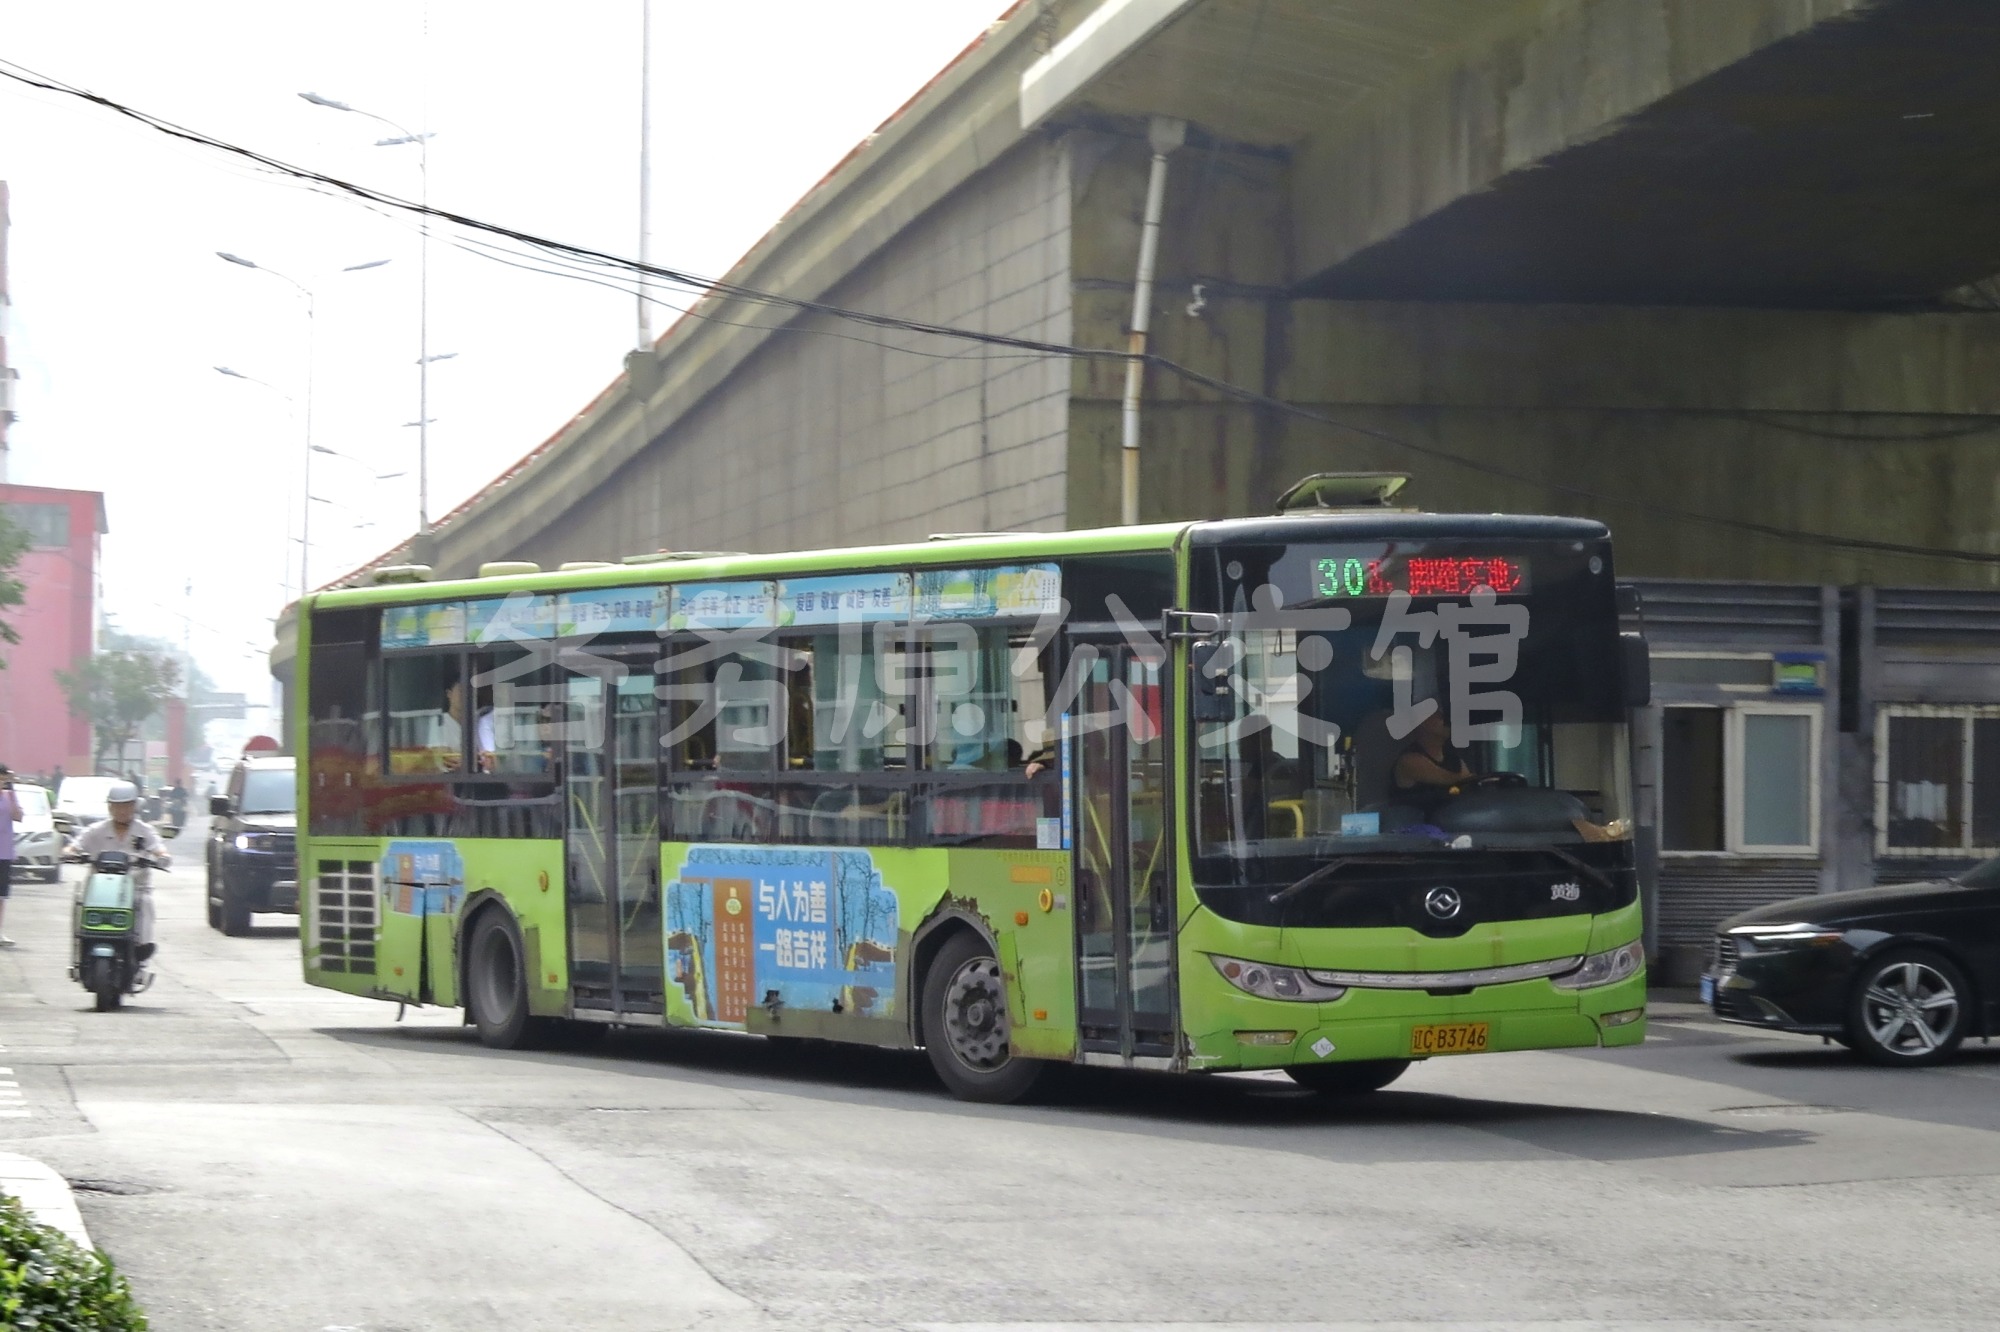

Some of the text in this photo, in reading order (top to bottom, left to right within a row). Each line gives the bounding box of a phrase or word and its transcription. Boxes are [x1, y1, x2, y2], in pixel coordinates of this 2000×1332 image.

[796, 591, 815, 612] 爱国
[758, 879, 828, 924] 与人为善
[759, 928, 828, 970] 一路吉祥
